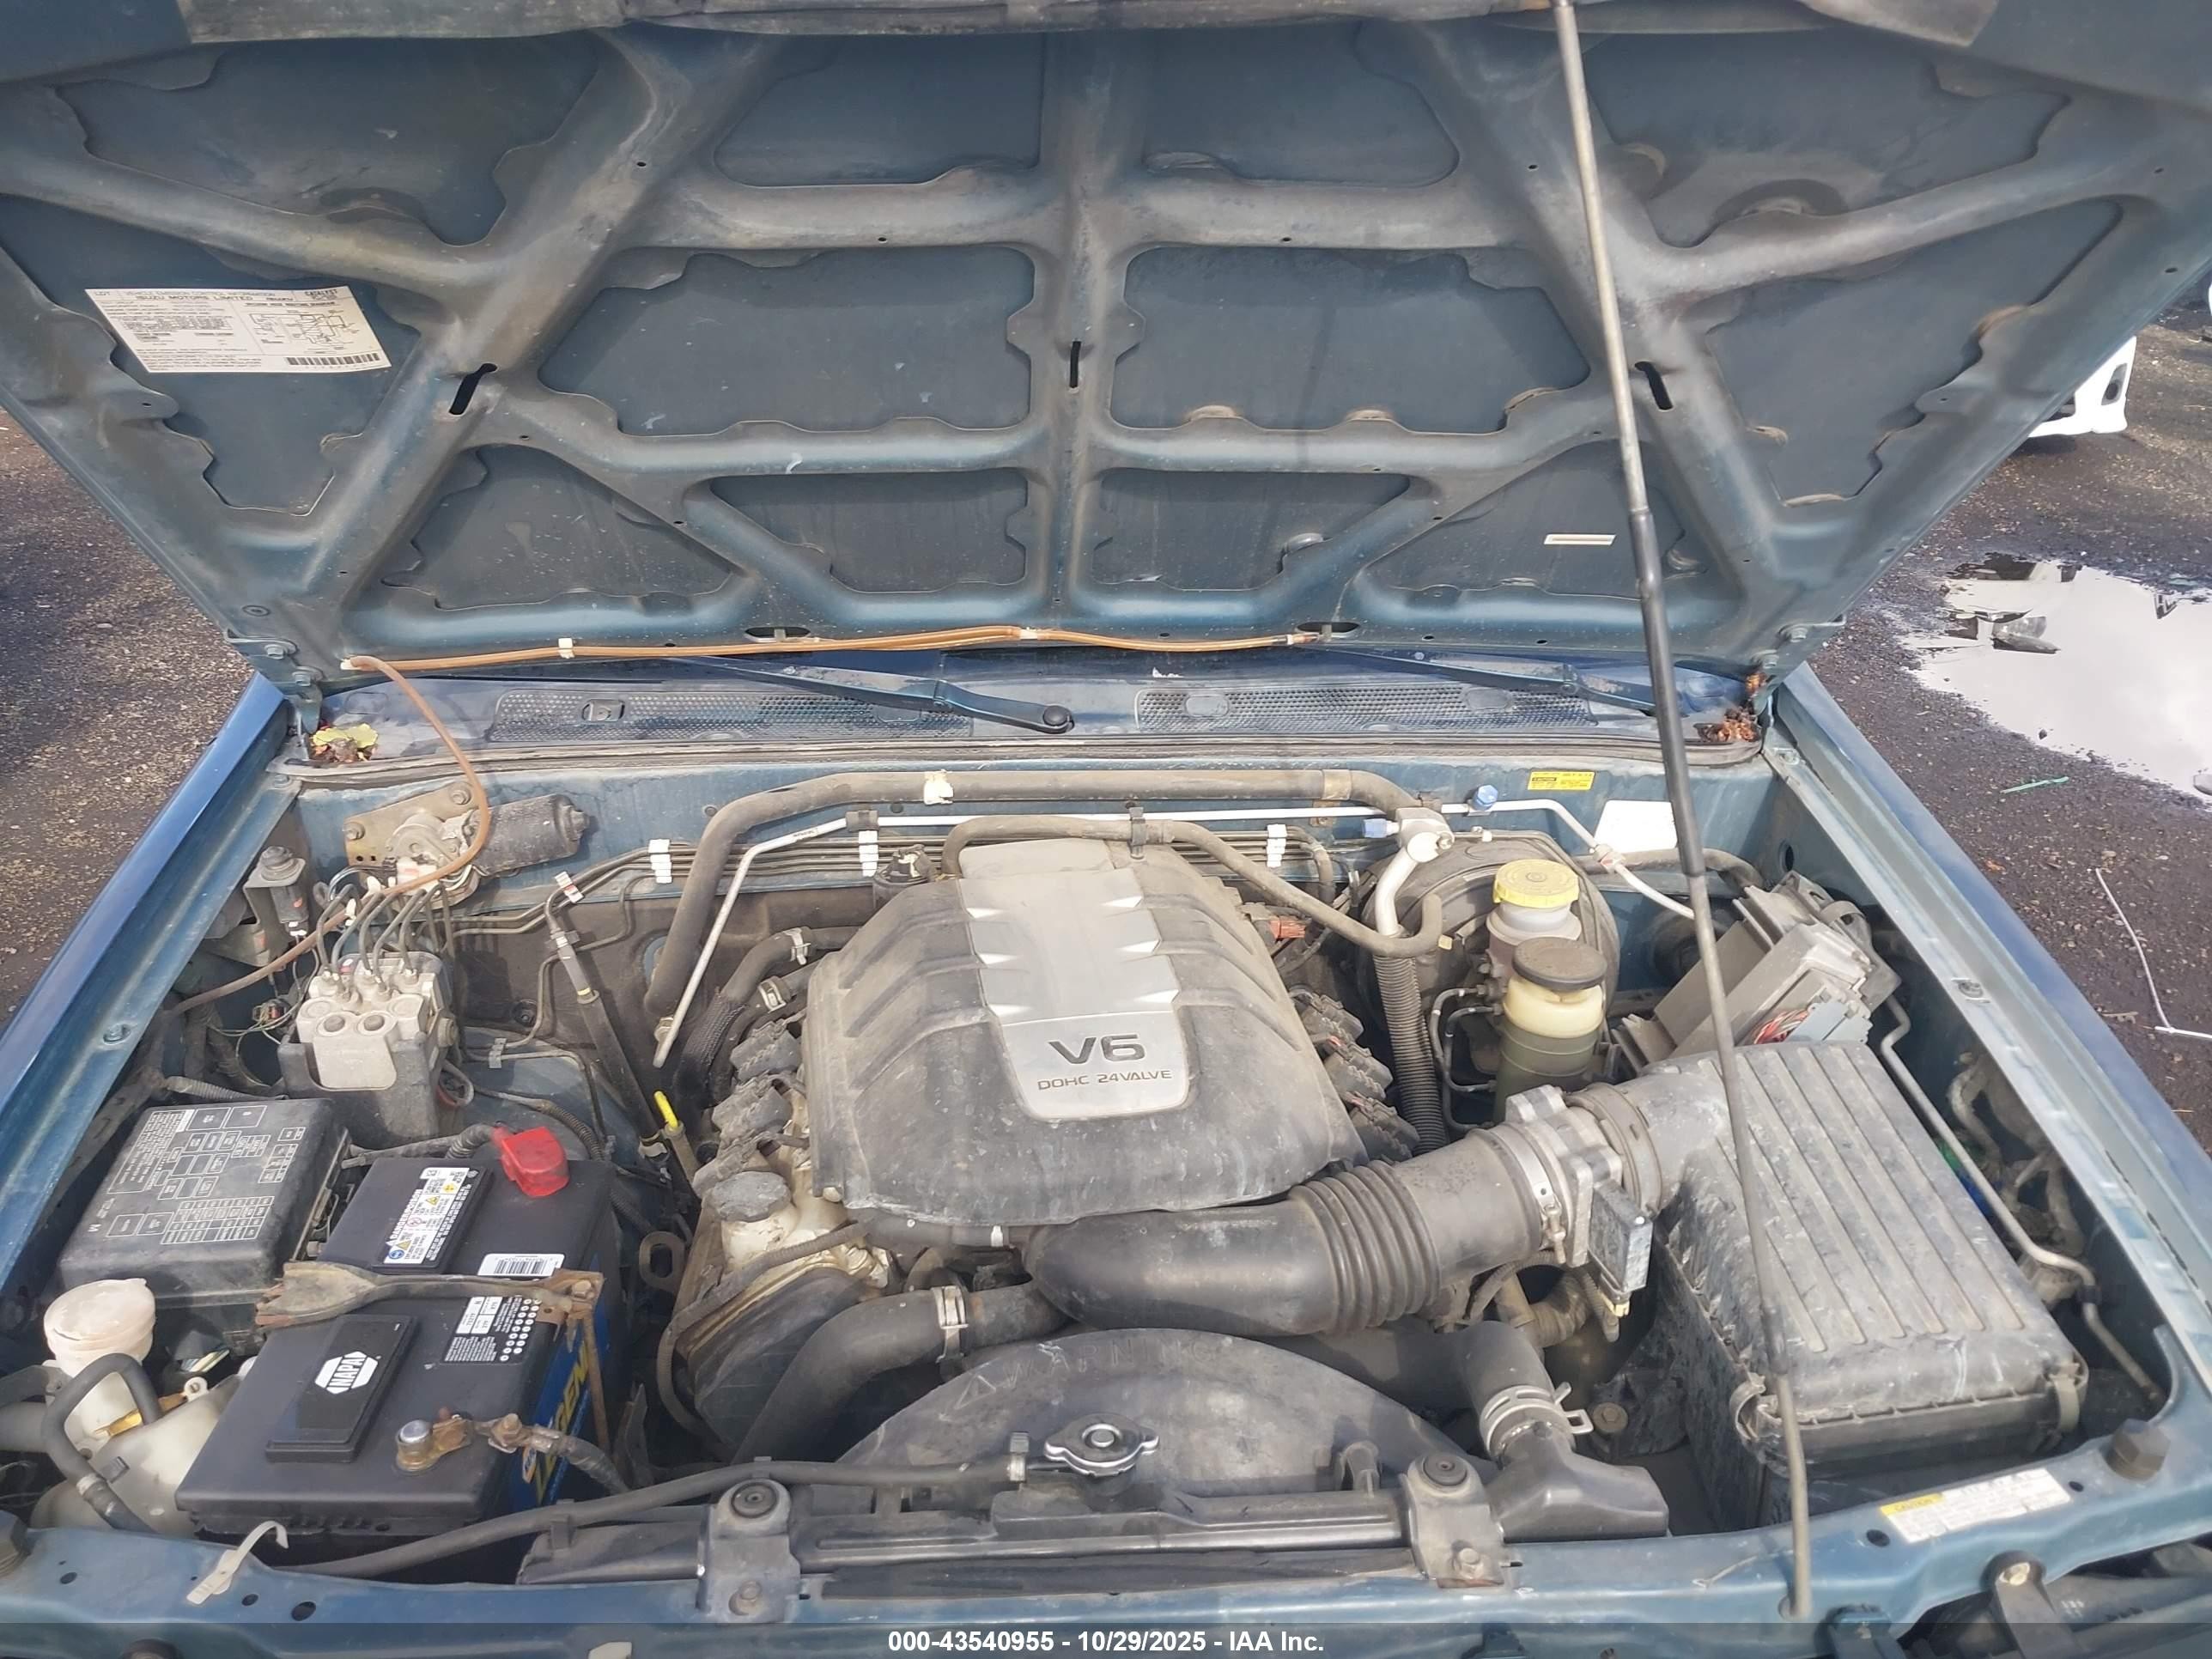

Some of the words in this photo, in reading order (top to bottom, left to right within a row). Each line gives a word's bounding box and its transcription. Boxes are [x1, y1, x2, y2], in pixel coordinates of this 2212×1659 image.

[1048, 1034, 1146, 1065] V6
[1037, 1075, 1090, 1091] DOHC
[1098, 1070, 1172, 1084] 24VALVE
[1001, 1336, 1217, 1389] WARNING
